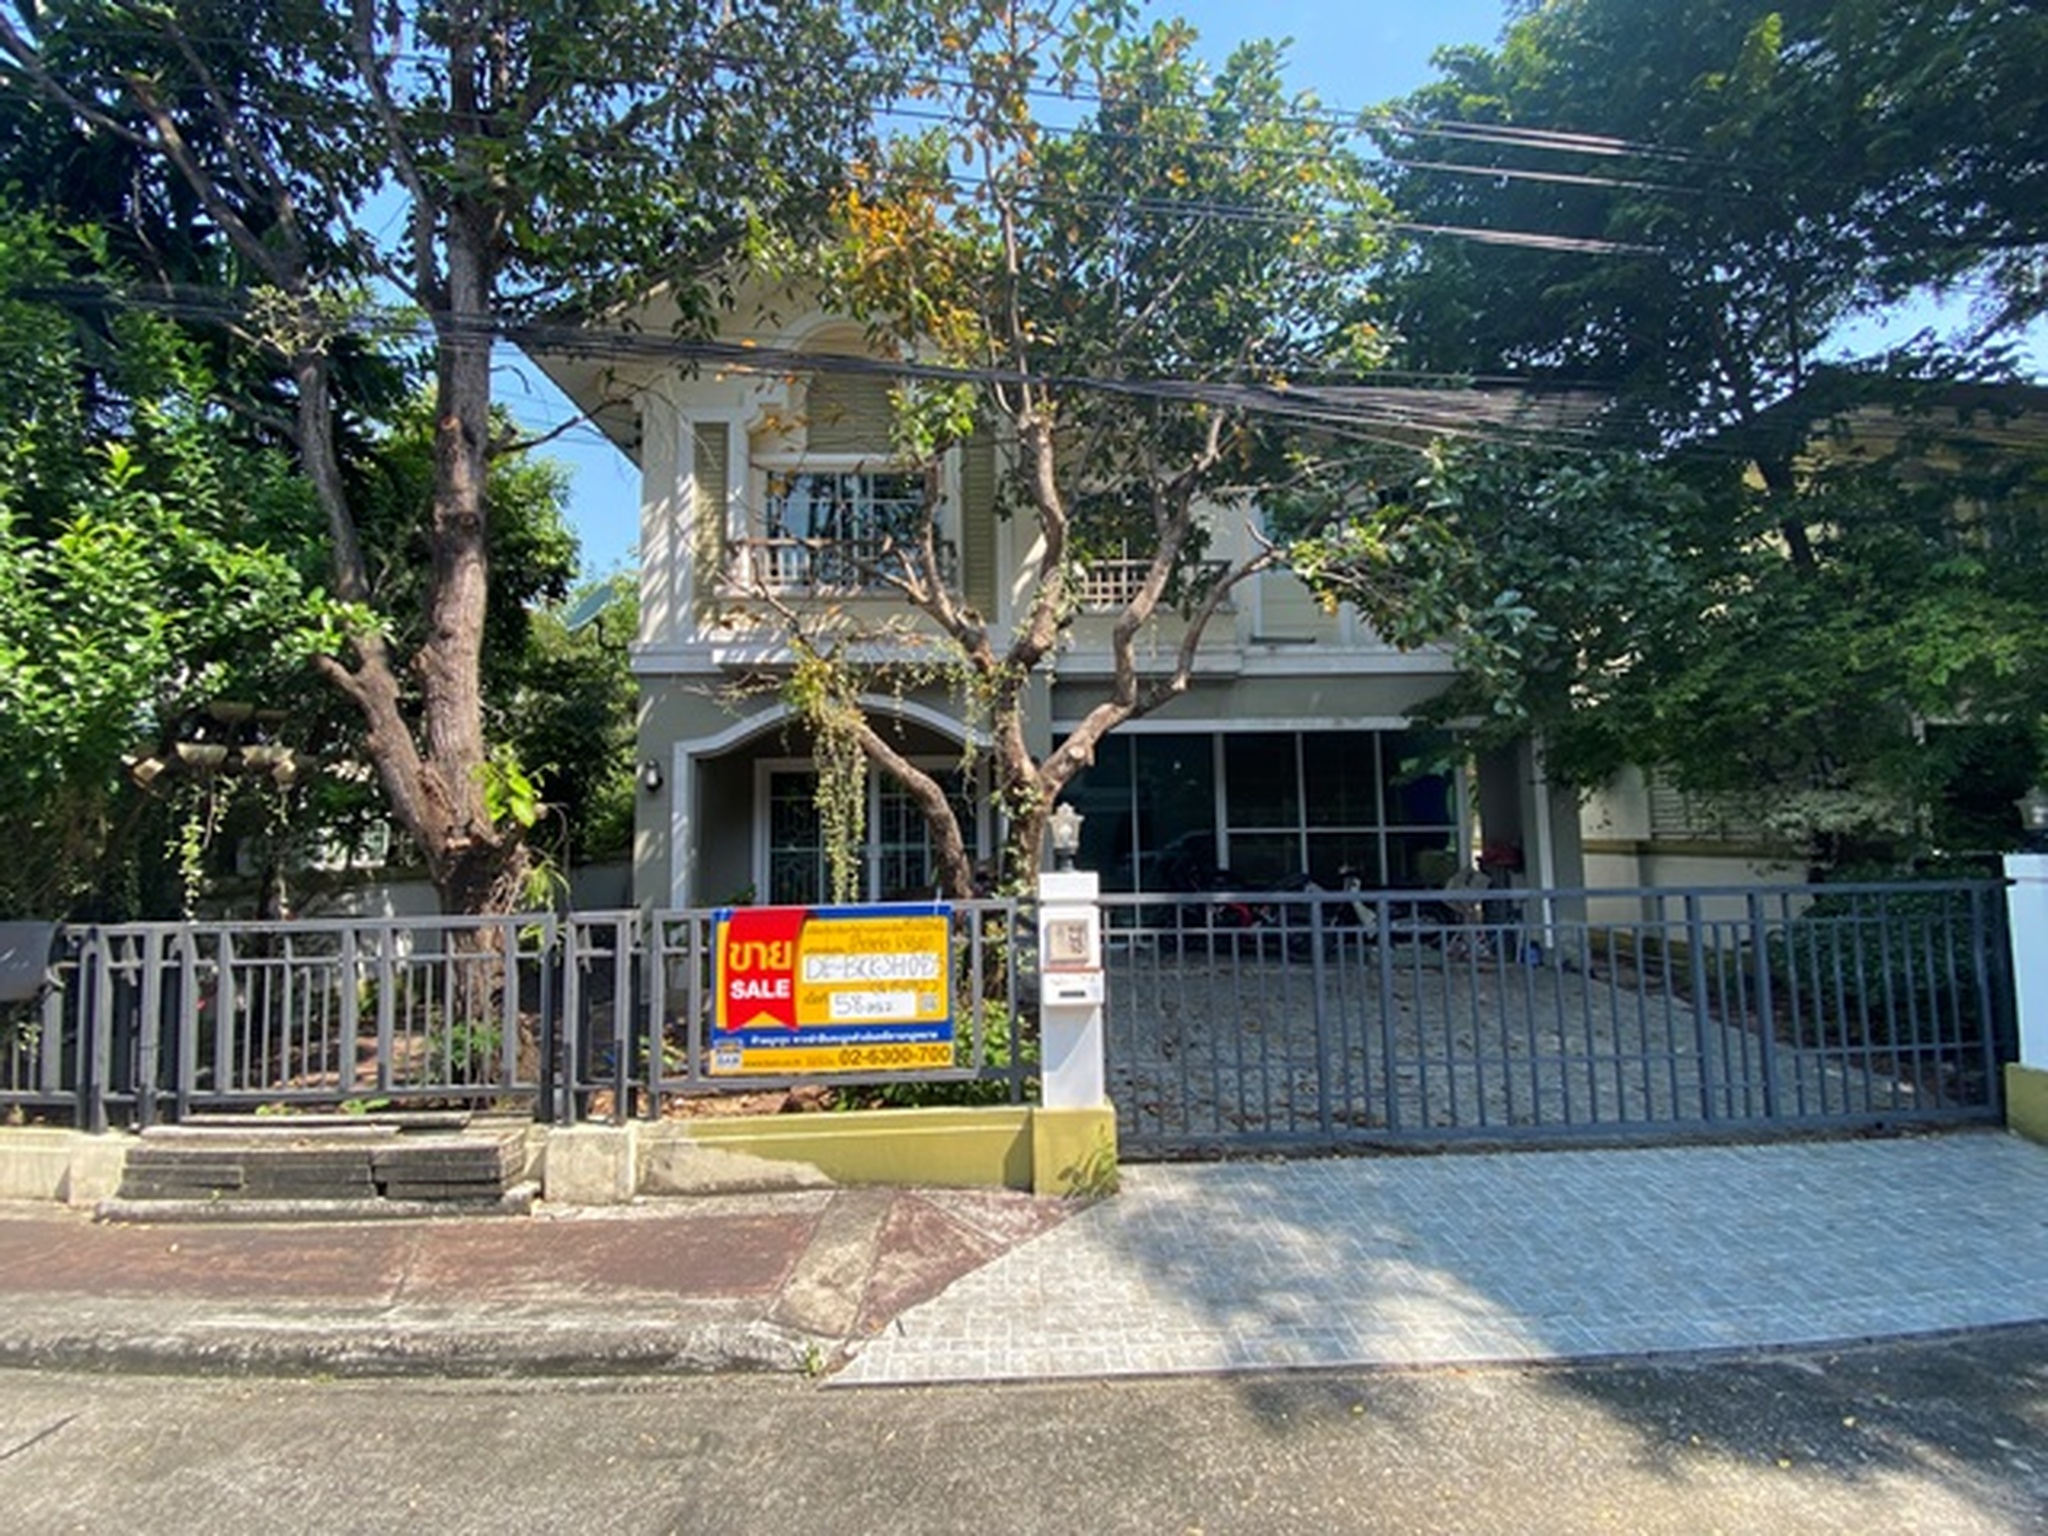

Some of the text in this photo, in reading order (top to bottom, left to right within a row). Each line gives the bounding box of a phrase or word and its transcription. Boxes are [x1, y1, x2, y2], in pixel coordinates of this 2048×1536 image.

[729, 940, 793, 972] ขาย
[730, 979, 791, 1000] SALE
[838, 1045, 951, 1067] 02-6300-700
